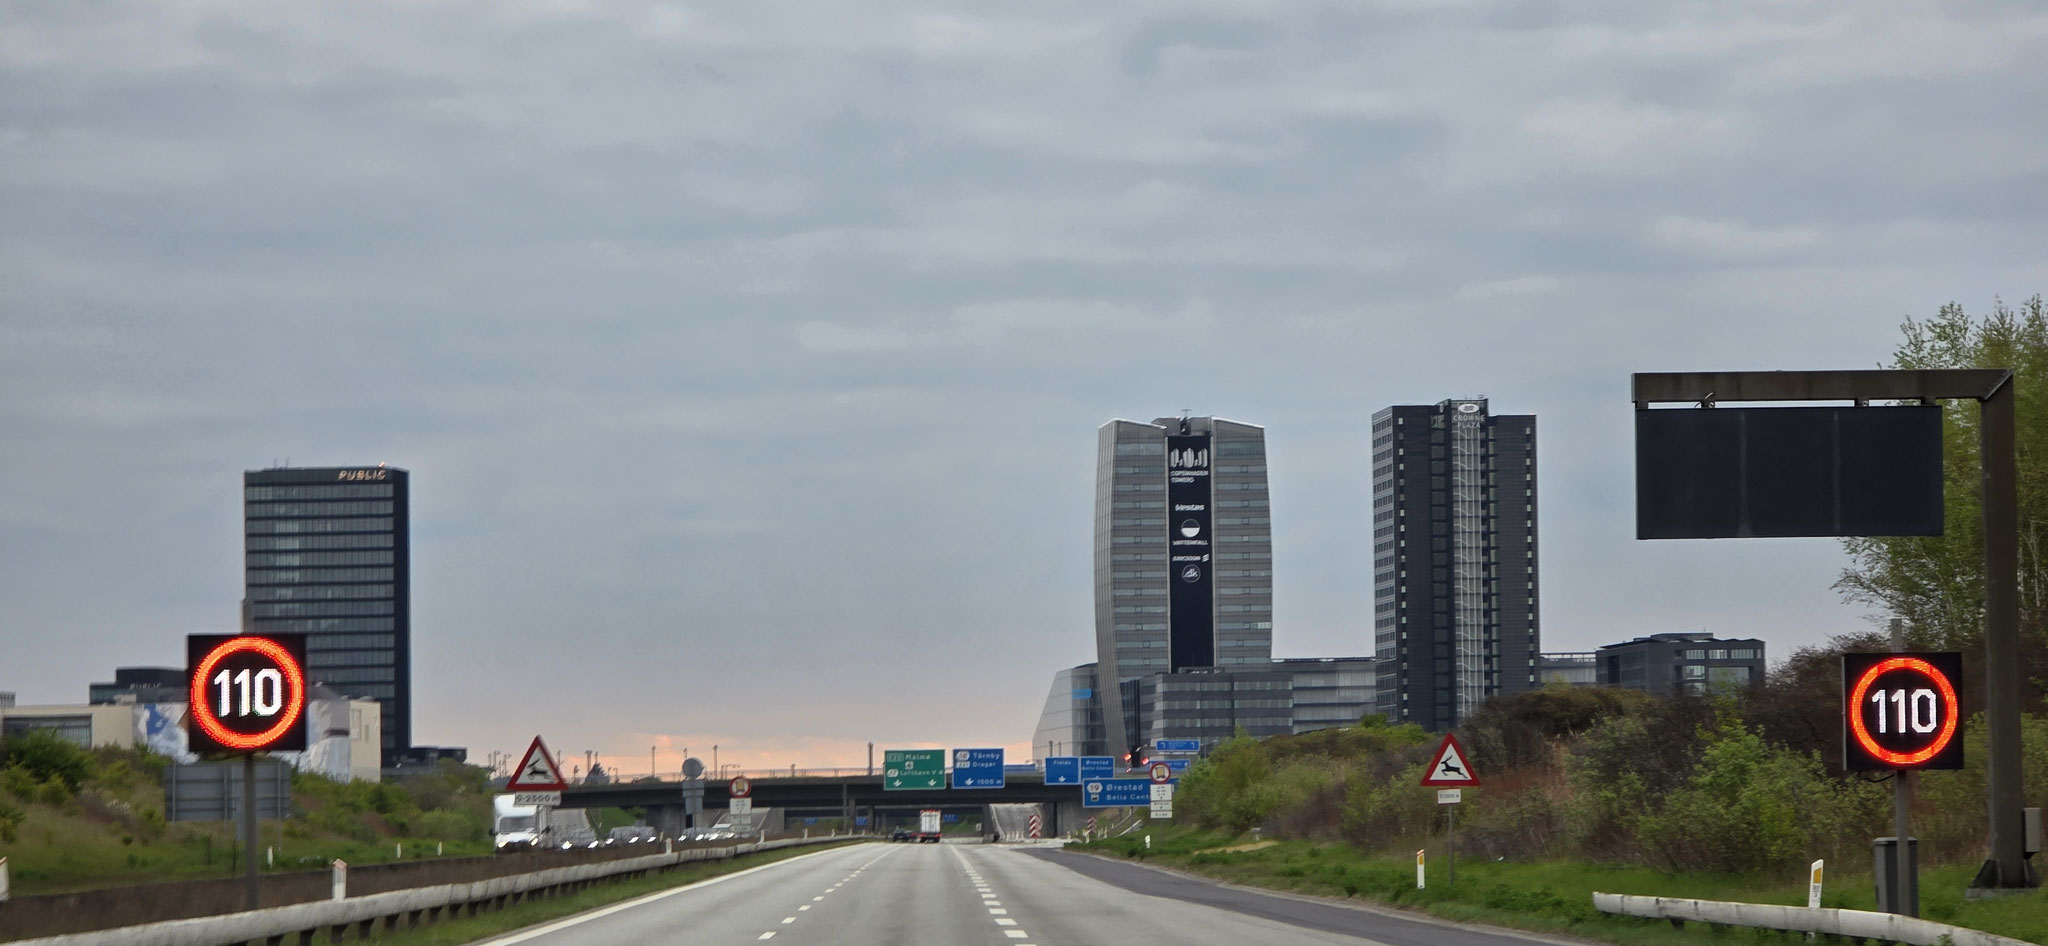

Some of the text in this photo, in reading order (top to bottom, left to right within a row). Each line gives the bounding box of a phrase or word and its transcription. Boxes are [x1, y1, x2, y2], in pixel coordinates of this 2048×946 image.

[338, 470, 386, 480] PUBLIC
[213, 668, 282, 717] 110
[1871, 688, 1937, 733] 110
[973, 752, 1000, 760] Tårnby
[1106, 783, 1143, 791] Ørestad
